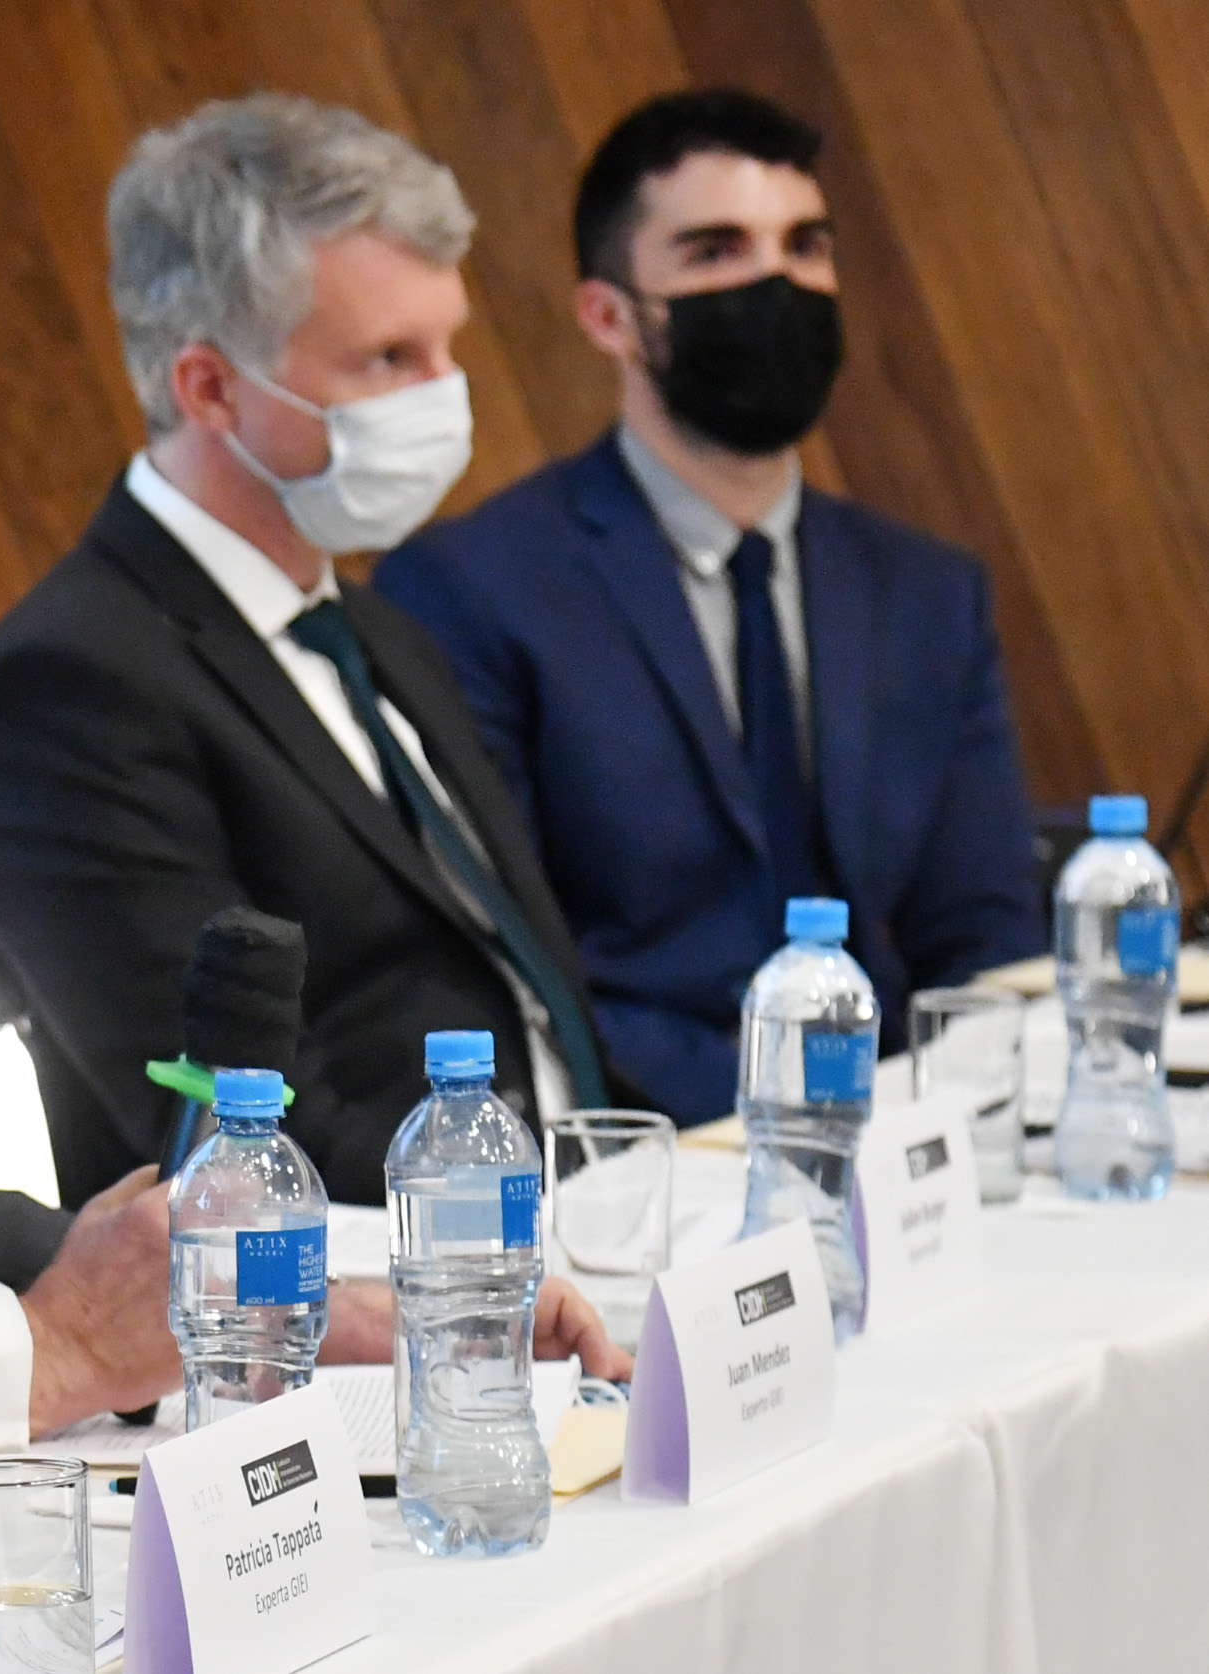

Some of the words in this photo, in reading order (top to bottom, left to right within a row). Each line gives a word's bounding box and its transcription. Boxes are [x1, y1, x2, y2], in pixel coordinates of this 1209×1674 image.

[244, 1237, 286, 1248] ATIX
[298, 1244, 314, 1256] THE
[728, 1363, 752, 1389] Juan
[752, 1344, 791, 1376] Mendez
[247, 1460, 282, 1500] CIDH
[225, 1538, 273, 1581] Patricia
[272, 1499, 322, 1561] Tappatá
[255, 1585, 290, 1615] Experta
[290, 1572, 309, 1598] GIEI
